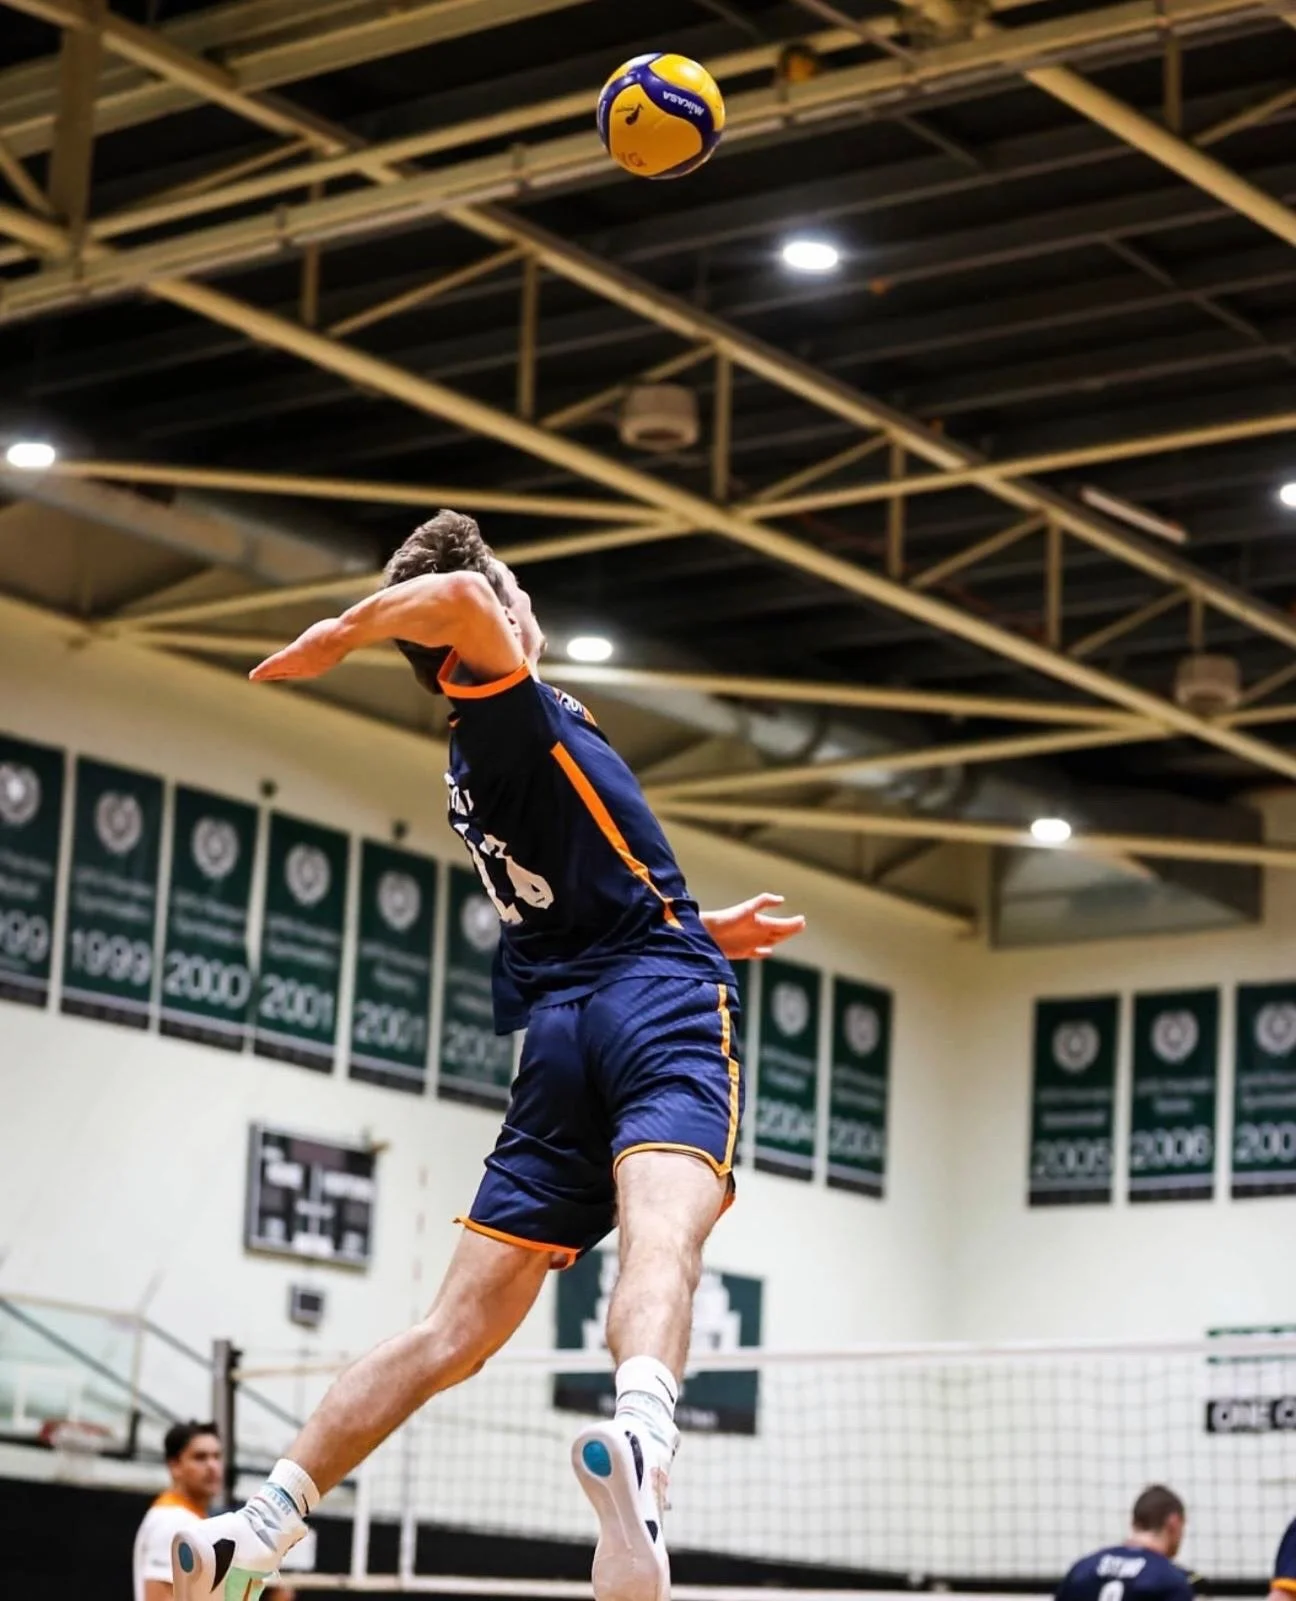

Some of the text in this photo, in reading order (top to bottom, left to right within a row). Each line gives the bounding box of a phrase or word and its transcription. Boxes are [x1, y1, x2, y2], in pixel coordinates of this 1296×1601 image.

[71, 928, 152, 987] 1999
[163, 949, 251, 1009] 2000
[260, 974, 334, 1031] 2001
[1131, 1125, 1210, 1169] 2006
[1235, 1121, 1296, 1164] 200
